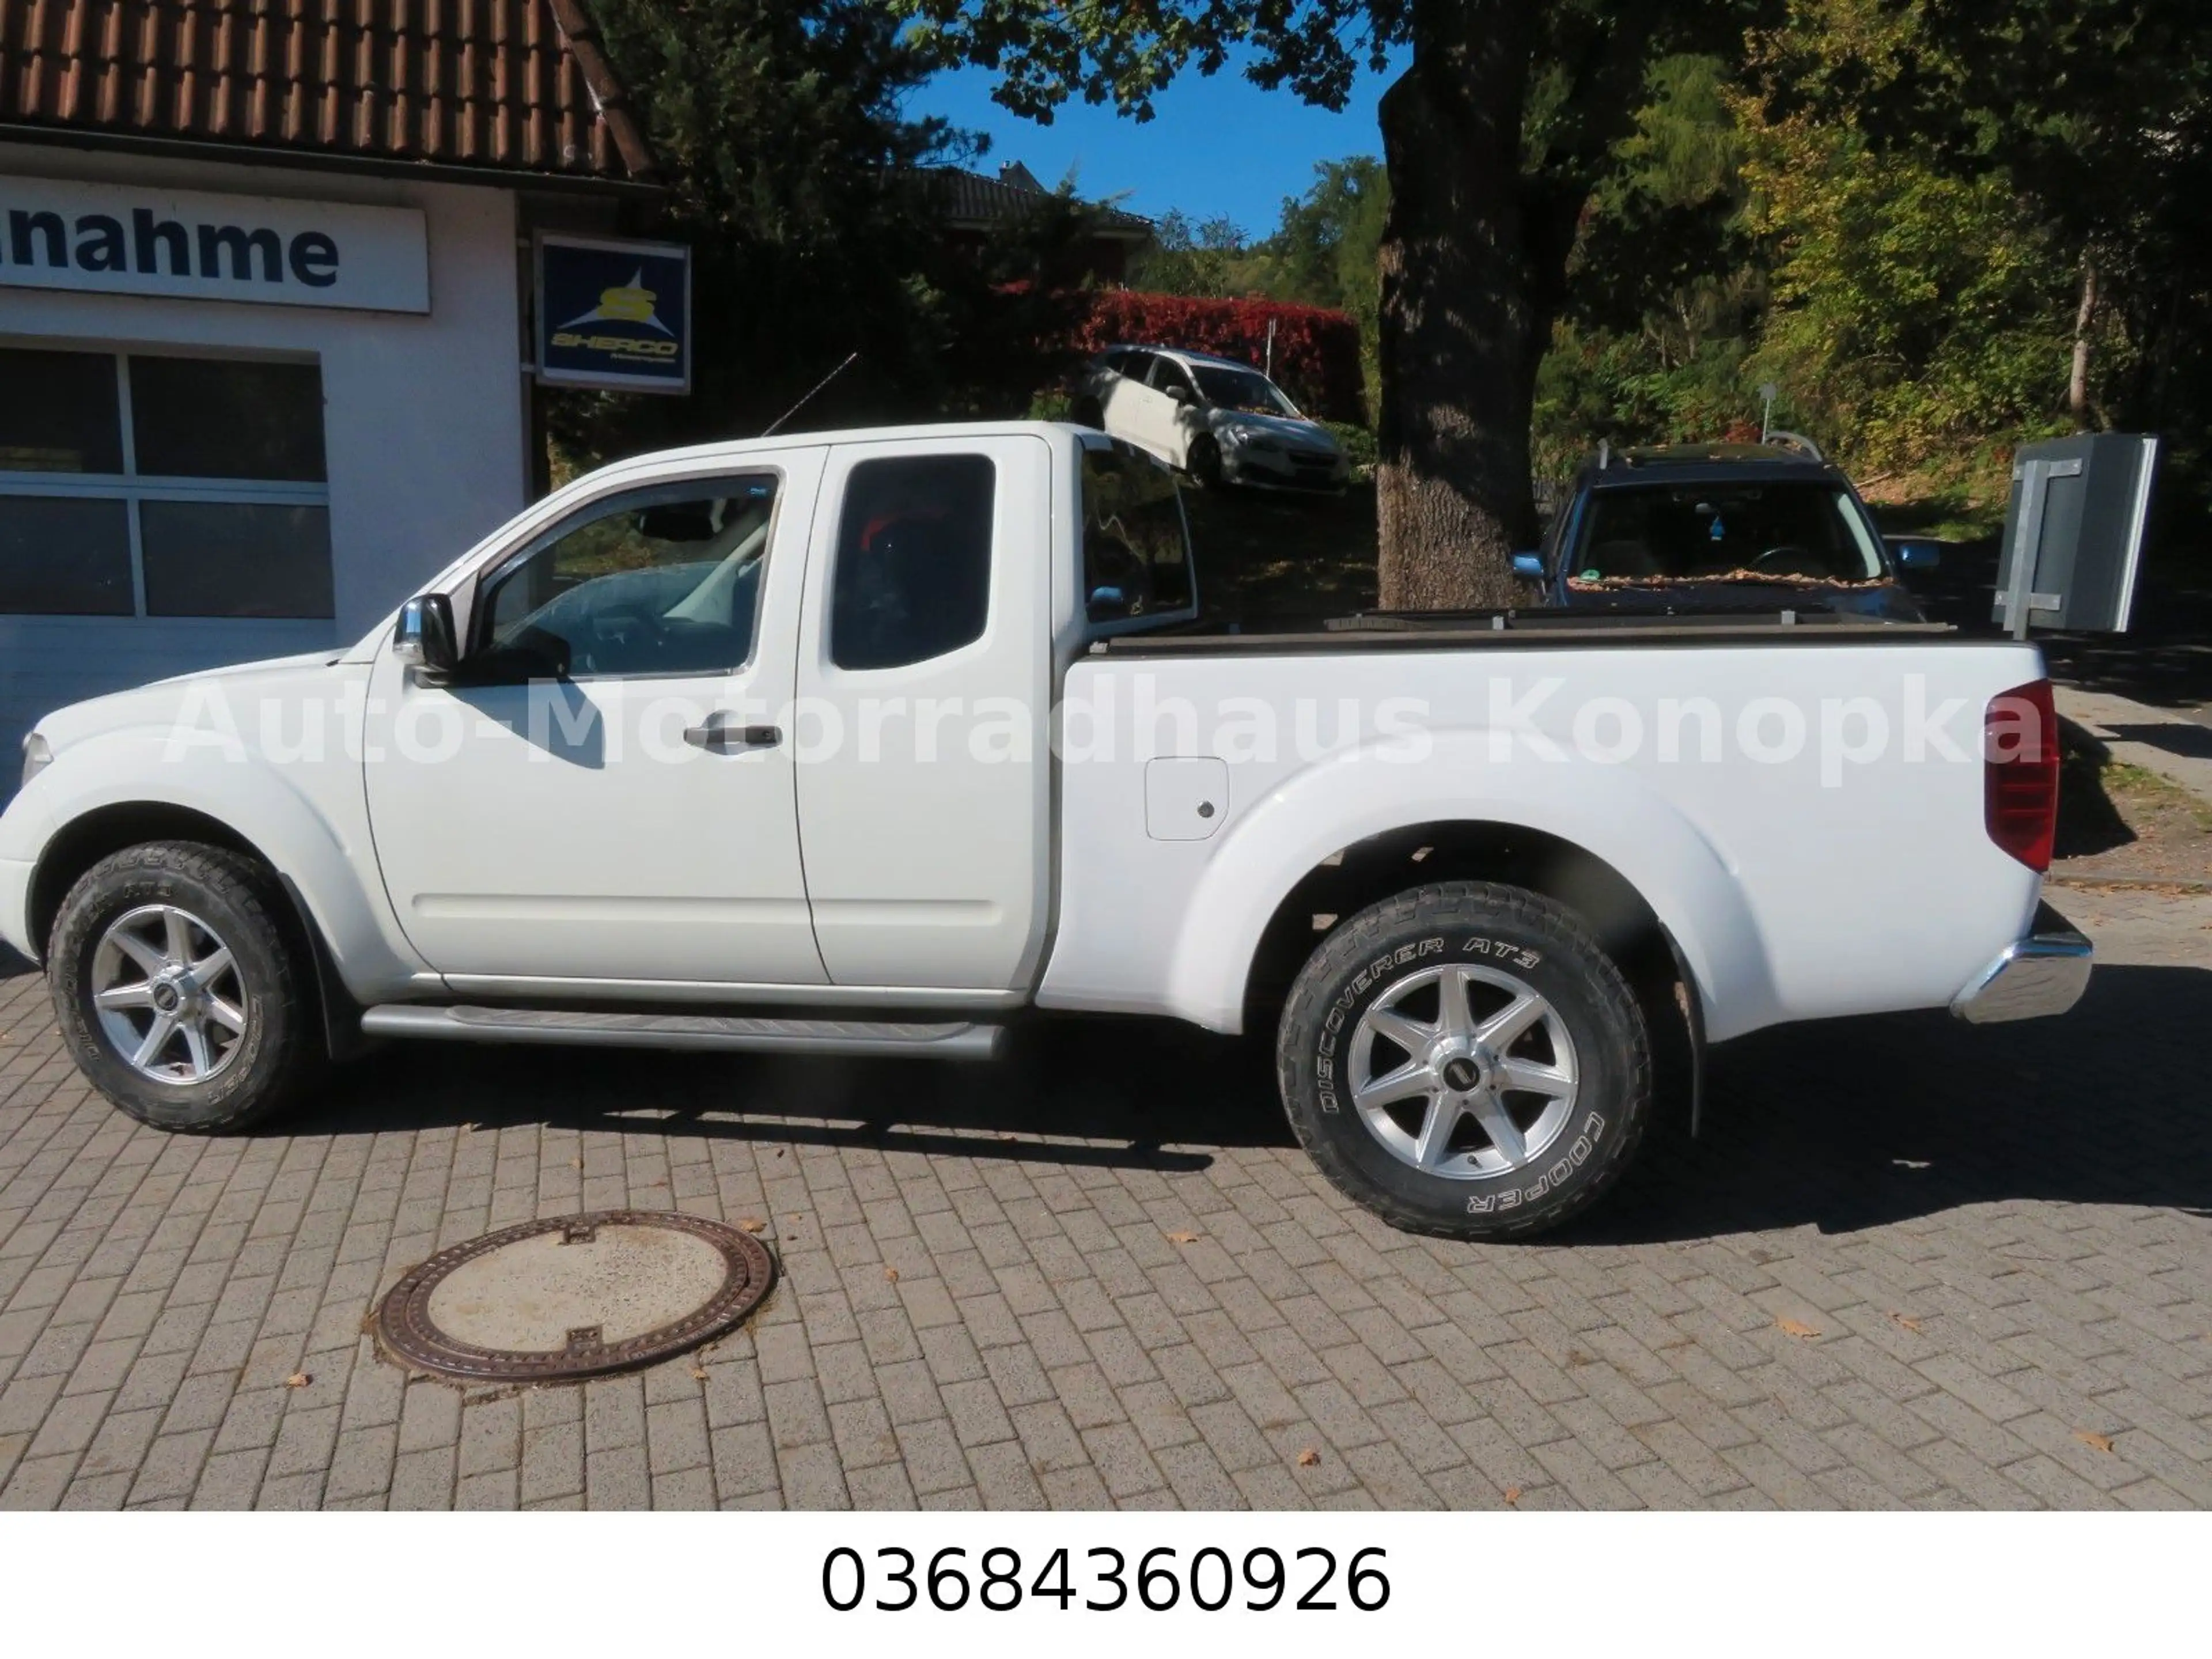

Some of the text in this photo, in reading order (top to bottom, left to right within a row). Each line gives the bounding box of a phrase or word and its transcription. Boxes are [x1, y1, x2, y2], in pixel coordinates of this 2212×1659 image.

[0, 208, 340, 287] nahme
[1317, 937, 1542, 1113] DISCOVERER AT3
[1467, 1111, 1605, 1213] COOPER
